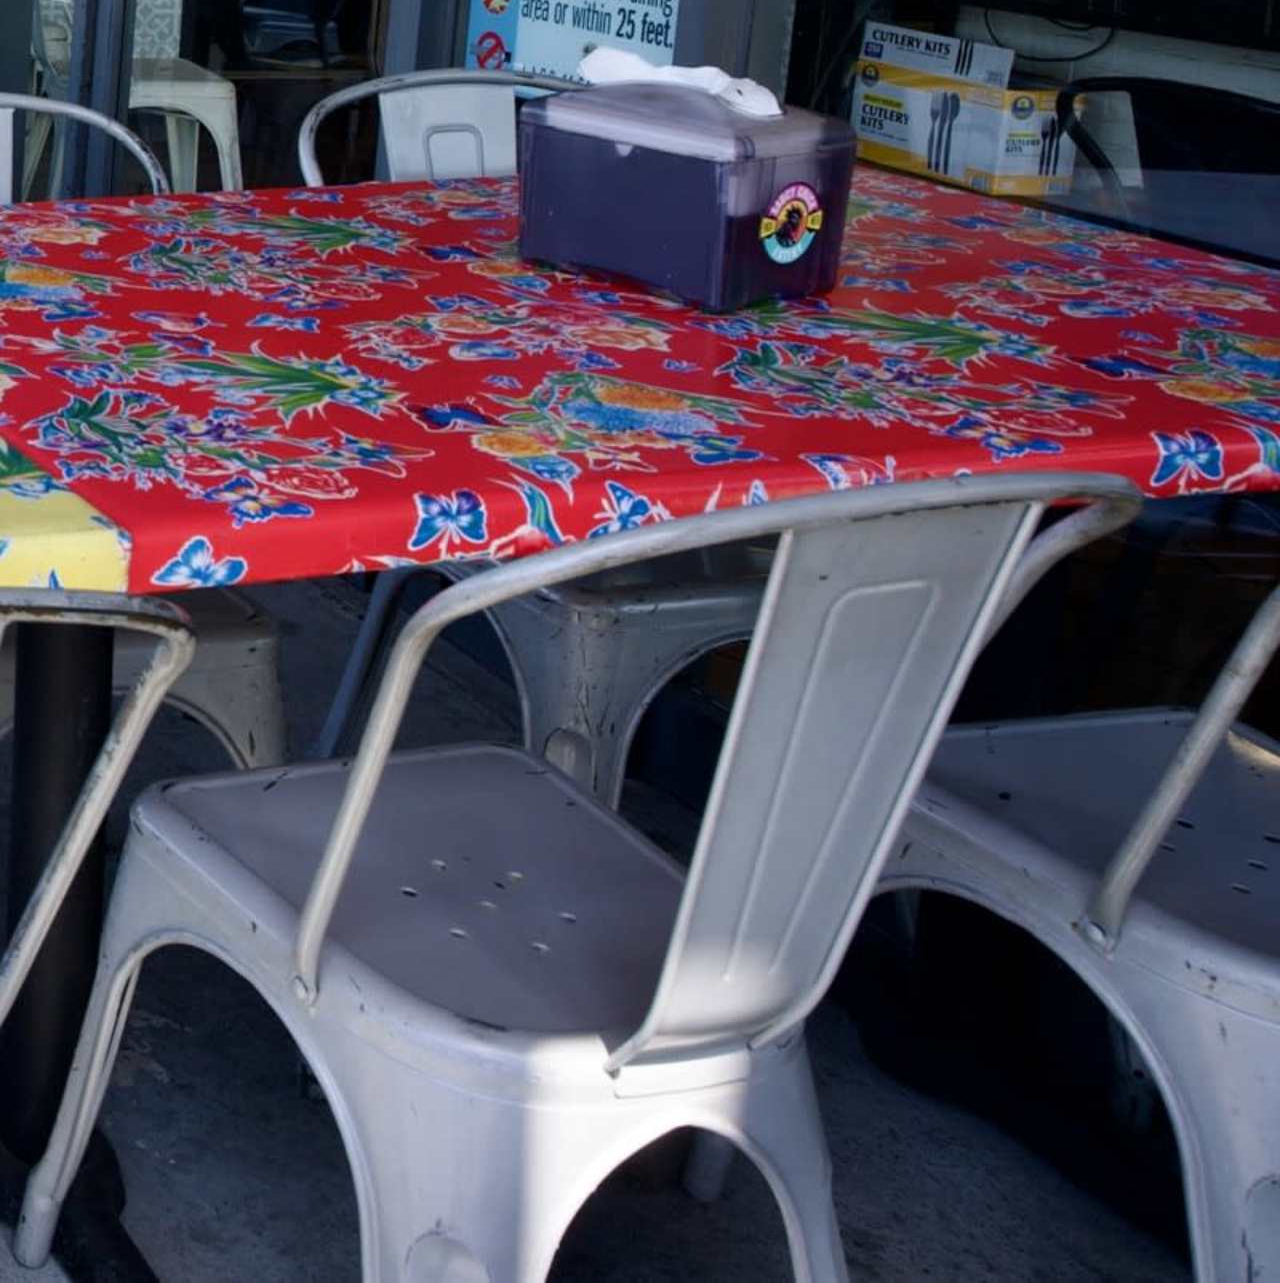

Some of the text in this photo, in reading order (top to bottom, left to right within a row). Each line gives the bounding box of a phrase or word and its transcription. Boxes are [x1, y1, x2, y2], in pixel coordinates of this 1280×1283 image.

[553, 0, 568, 25] or
[571, 0, 613, 36] within
[616, 7, 636, 41] 25
[639, 12, 673, 49] feet.
[872, 29, 922, 49] CUTLERY
[924, 40, 951, 56] KITS
[860, 116, 884, 131] KITS
[861, 103, 910, 126] CUTLERY
